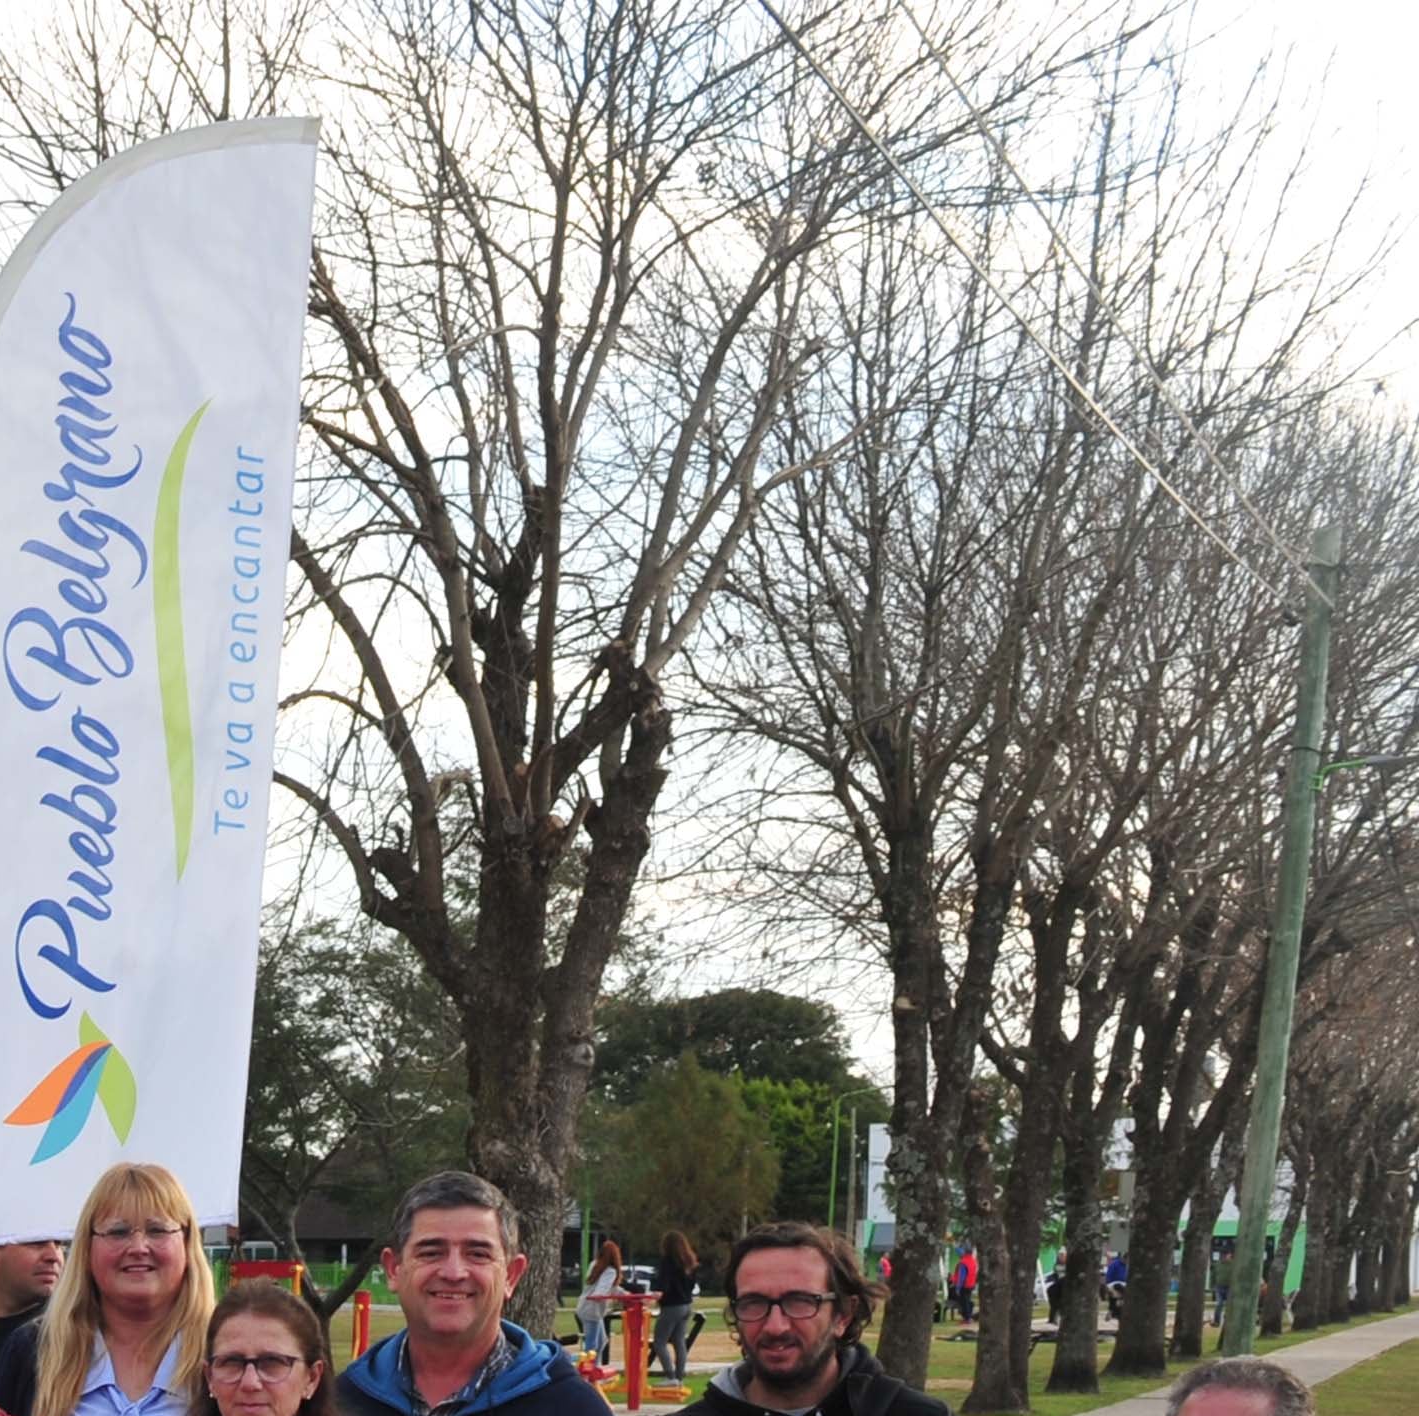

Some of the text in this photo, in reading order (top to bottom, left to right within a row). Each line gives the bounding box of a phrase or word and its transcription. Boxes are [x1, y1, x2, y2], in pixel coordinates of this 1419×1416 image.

[3, 292, 150, 1021] Pueblo Belgrano
[213, 443, 266, 836] Te va a encantar
